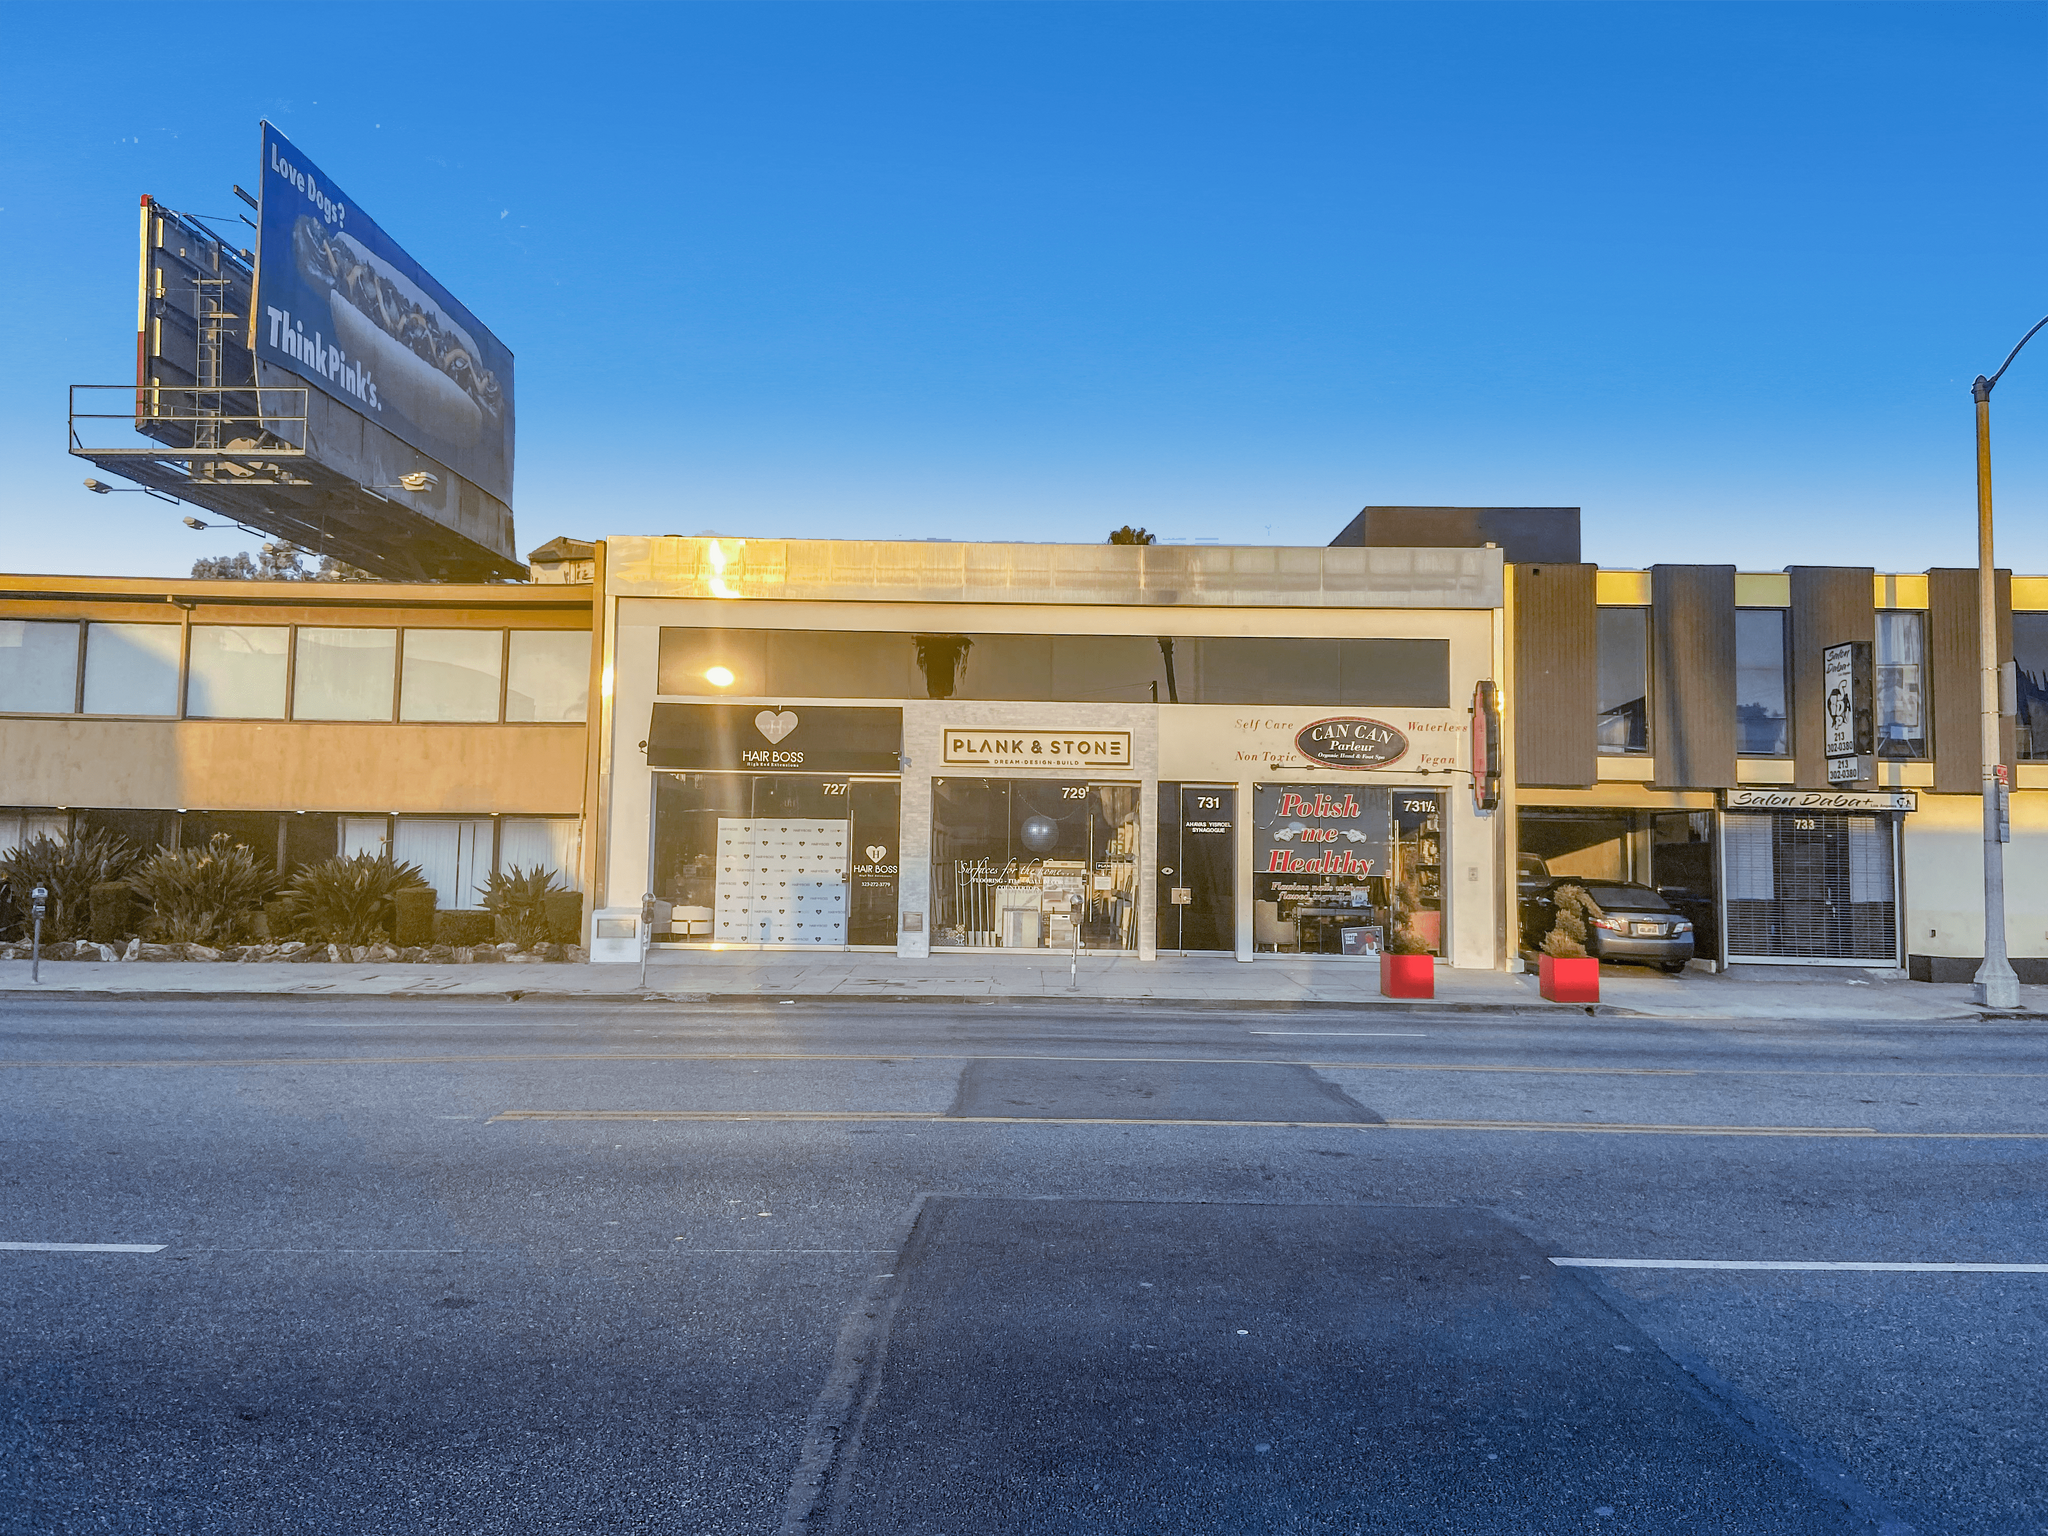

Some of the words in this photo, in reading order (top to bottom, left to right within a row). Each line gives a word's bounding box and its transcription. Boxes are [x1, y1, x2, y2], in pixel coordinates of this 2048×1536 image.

[271, 142, 305, 193] Love
[307, 173, 345, 229] Dogs?
[267, 305, 328, 377] Think
[328, 344, 382, 412] Pink's.
[1826, 648, 1851, 662] Salon
[1234, 718, 1261, 732] Self
[1264, 718, 1294, 730] Care
[1408, 721, 1468, 732] Waterless
[1311, 723, 1350, 741] CAN
[1354, 724, 1394, 745] CAN
[1834, 731, 1845, 742] 213
[953, 738, 1024, 754] PLANK
[1031, 739, 1043, 754] &
[1050, 740, 1121, 755] STONE
[1329, 740, 1375, 752] Parleur
[1827, 740, 1853, 753] 302-0380
[742, 750, 770, 762] HAIR
[772, 751, 804, 763] BOSS
[1234, 750, 1258, 761] Non
[1262, 751, 1297, 762] Toxic
[1318, 751, 1339, 760] Organic
[1420, 753, 1455, 768] Vegan
[1837, 759, 1849, 769] 213
[822, 783, 848, 795] 727
[1062, 787, 1086, 799] 729
[1197, 796, 1220, 809] 731
[1278, 792, 1362, 818] Polish
[1733, 792, 1797, 807] Salon
[1799, 793, 1874, 808] Daba+
[1794, 819, 1815, 830] 733
[1300, 827, 1339, 843] me
[853, 864, 873, 873] HAIR
[875, 864, 898, 874] BOSS
[1267, 849, 1375, 881] Healthy
